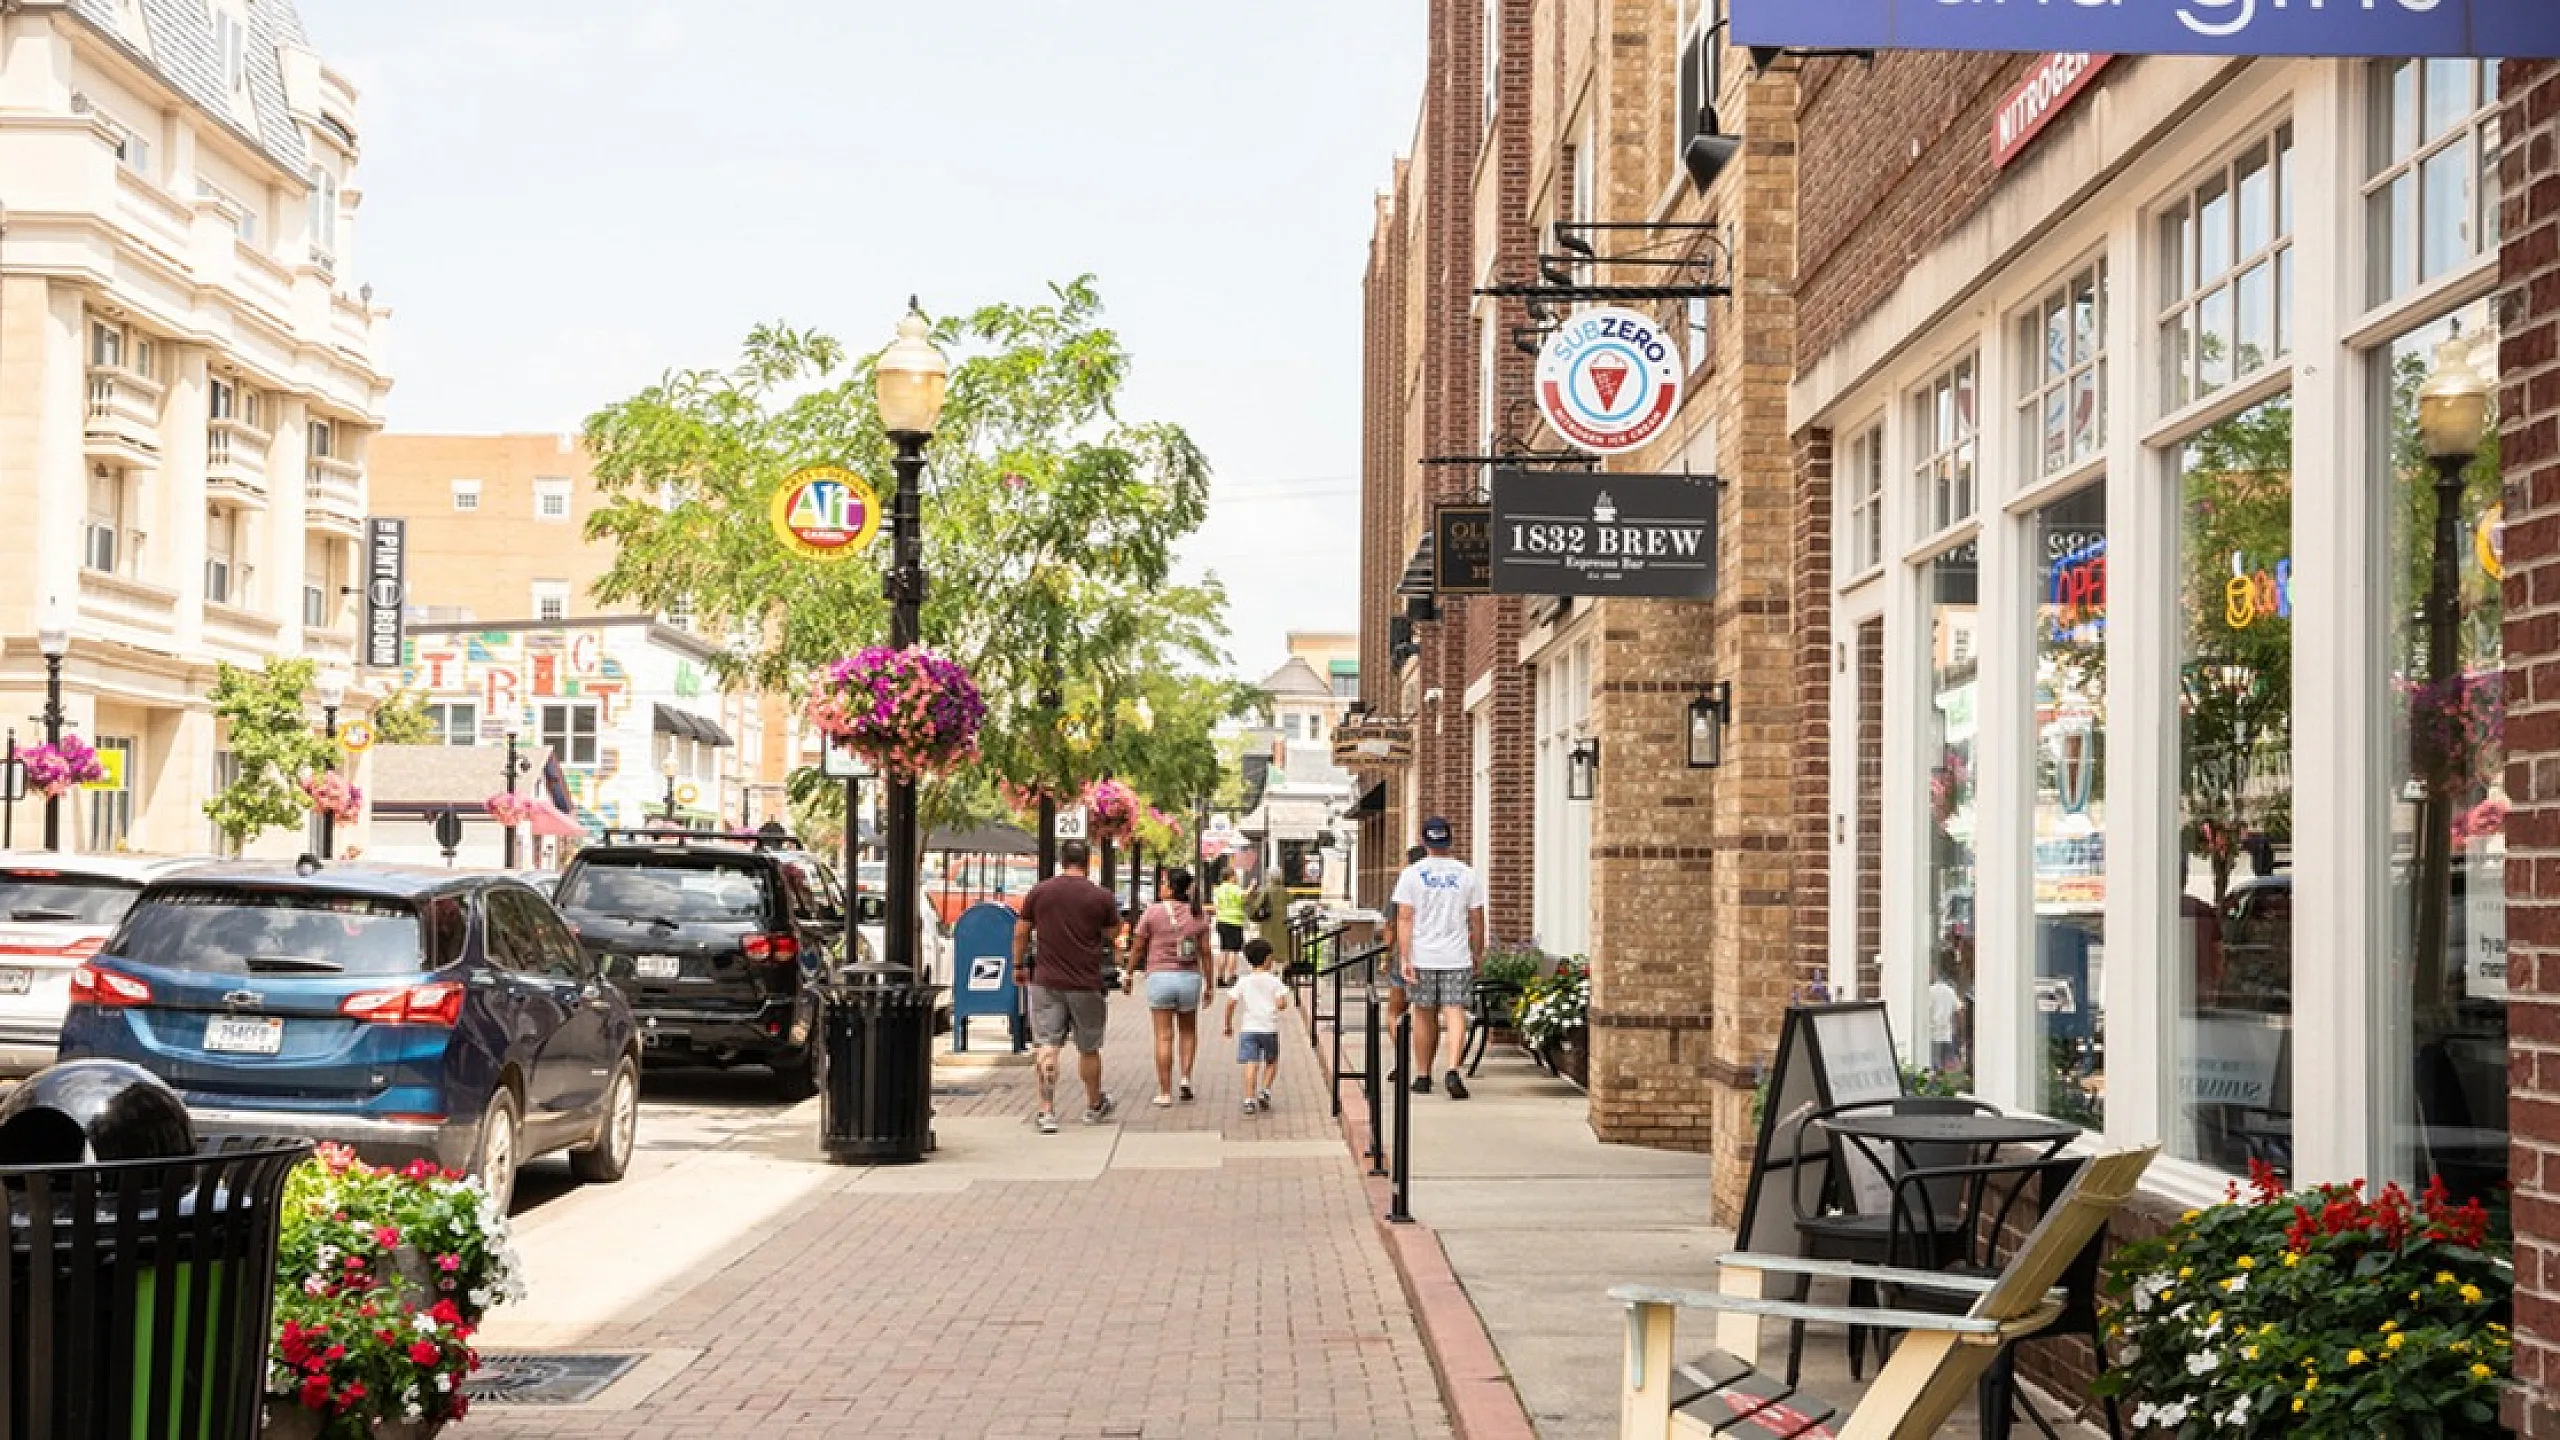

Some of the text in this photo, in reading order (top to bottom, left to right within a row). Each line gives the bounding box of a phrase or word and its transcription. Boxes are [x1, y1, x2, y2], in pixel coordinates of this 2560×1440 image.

[375, 536, 398, 579] PINT
[1511, 524, 1703, 555] 1832 BREW
[1565, 554, 1645, 571] Espresso Bar
[2057, 557, 2106, 626] OPE
[373, 609, 397, 664] ROOM
[1060, 815, 1079, 833] 20
